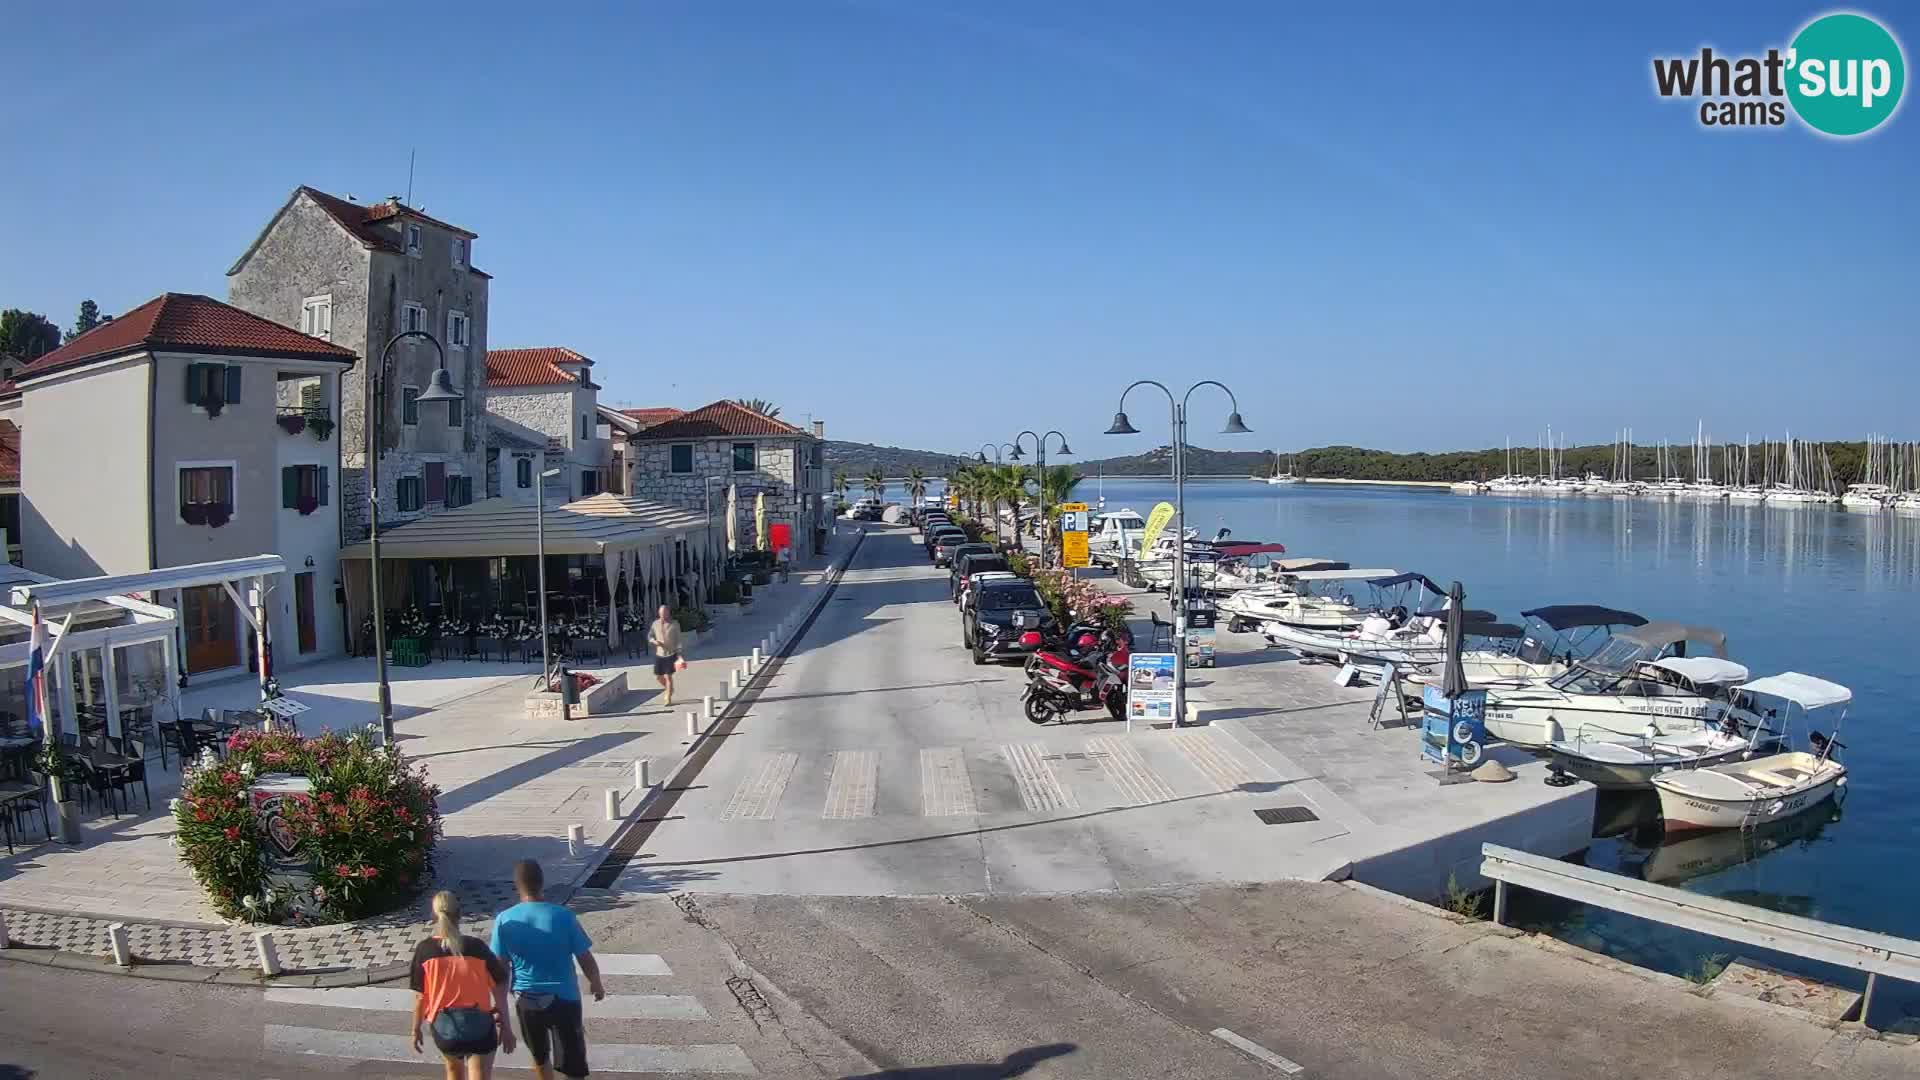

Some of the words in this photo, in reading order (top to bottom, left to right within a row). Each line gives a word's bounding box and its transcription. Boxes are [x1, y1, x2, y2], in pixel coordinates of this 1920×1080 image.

[1453, 696, 1483, 710] RENT
[1461, 707, 1484, 719] BOAT
[1664, 705, 1682, 715] RENT
